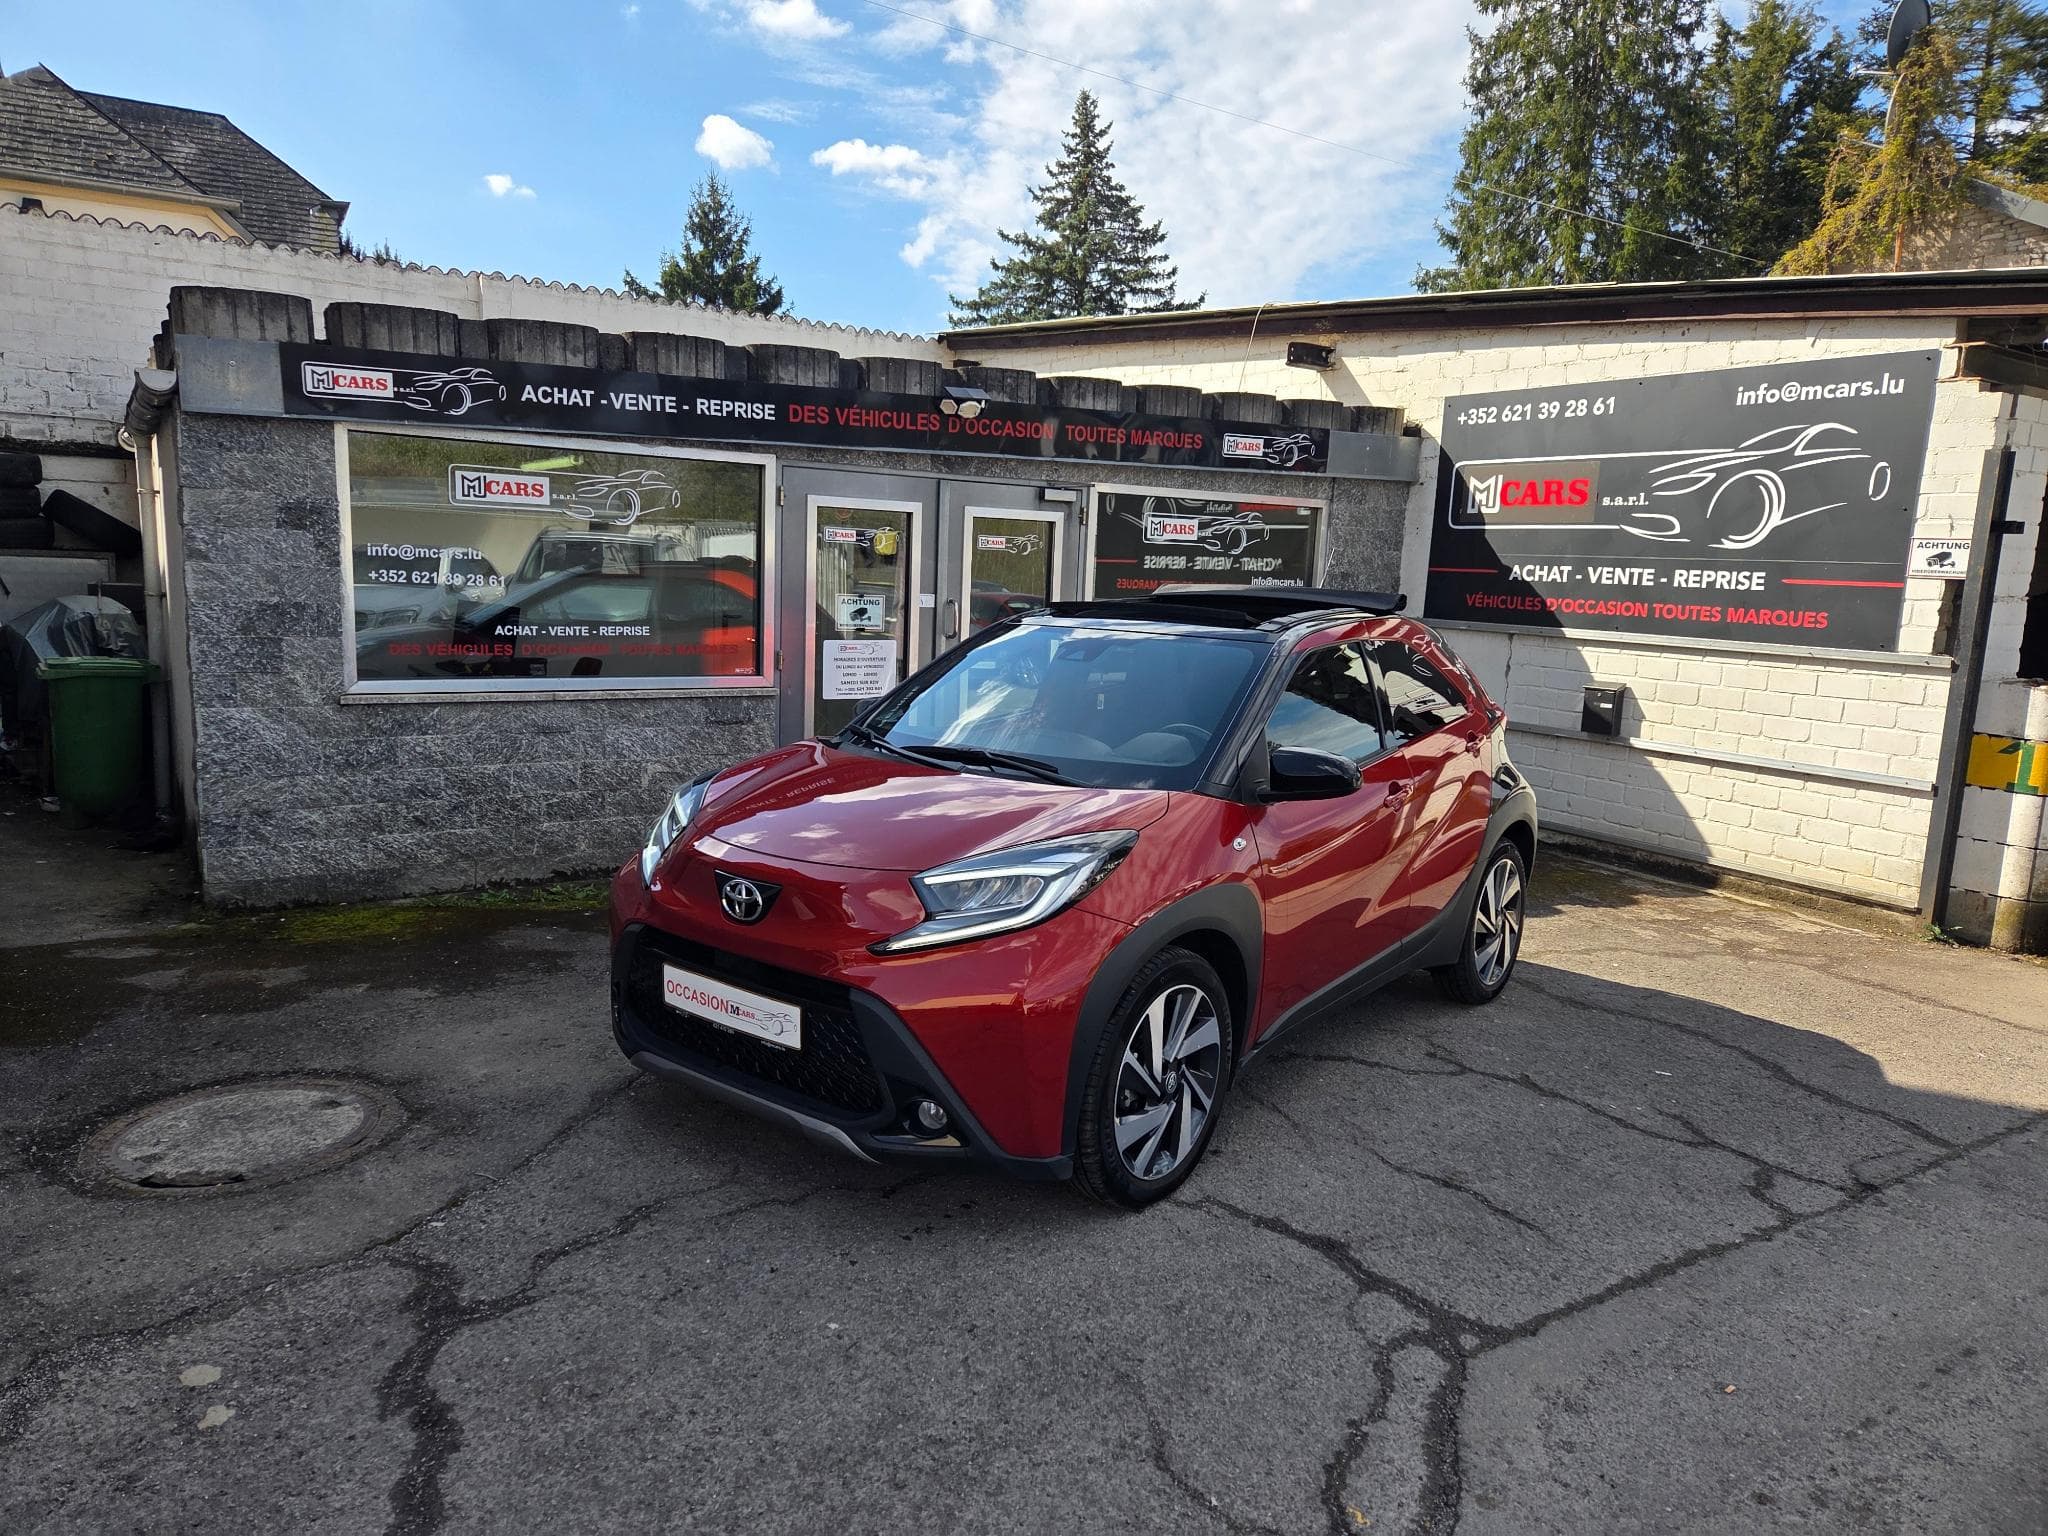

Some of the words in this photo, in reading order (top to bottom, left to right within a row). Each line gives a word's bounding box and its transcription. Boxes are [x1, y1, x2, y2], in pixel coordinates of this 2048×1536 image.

[1736, 372, 1905, 406] info@mcars.lu
[521, 384, 594, 407] ACHAT
[610, 393, 677, 413] VENTE
[696, 398, 776, 421] REPRISE
[788, 404, 830, 424] DES
[835, 404, 940, 431] VÉHICULES
[1065, 424, 1127, 444] TOUTES
[1131, 429, 1203, 449] MARQUES
[1457, 407, 1497, 425] +352
[1501, 403, 1532, 422] 621
[1538, 401, 1561, 420] 39
[1564, 399, 1588, 417] 28
[1593, 396, 1616, 416] 61
[1602, 493, 1649, 506] s.a.r.l.
[367, 543, 482, 560] info@mcars.lu
[1917, 542, 1970, 550] ACHTUNG
[368, 570, 407, 583] +352
[412, 571, 439, 584] 621
[467, 574, 484, 586] 28
[489, 575, 505, 587] 61
[1509, 565, 1572, 583] ACHAT
[1588, 567, 1656, 586] VENTE
[1674, 569, 1766, 591] REPRISE
[841, 598, 880, 606] ACHTUNG
[1466, 592, 1542, 611] VÉHICULES
[1546, 598, 1648, 618] D'OCCASION
[1653, 603, 1721, 622] TOUTES
[1726, 607, 1829, 629] MARQUES
[495, 625, 538, 636] ACHAT
[549, 626, 589, 636] VENTE
[600, 626, 650, 636] REPRISE
[666, 979, 729, 1014] OCCASION
